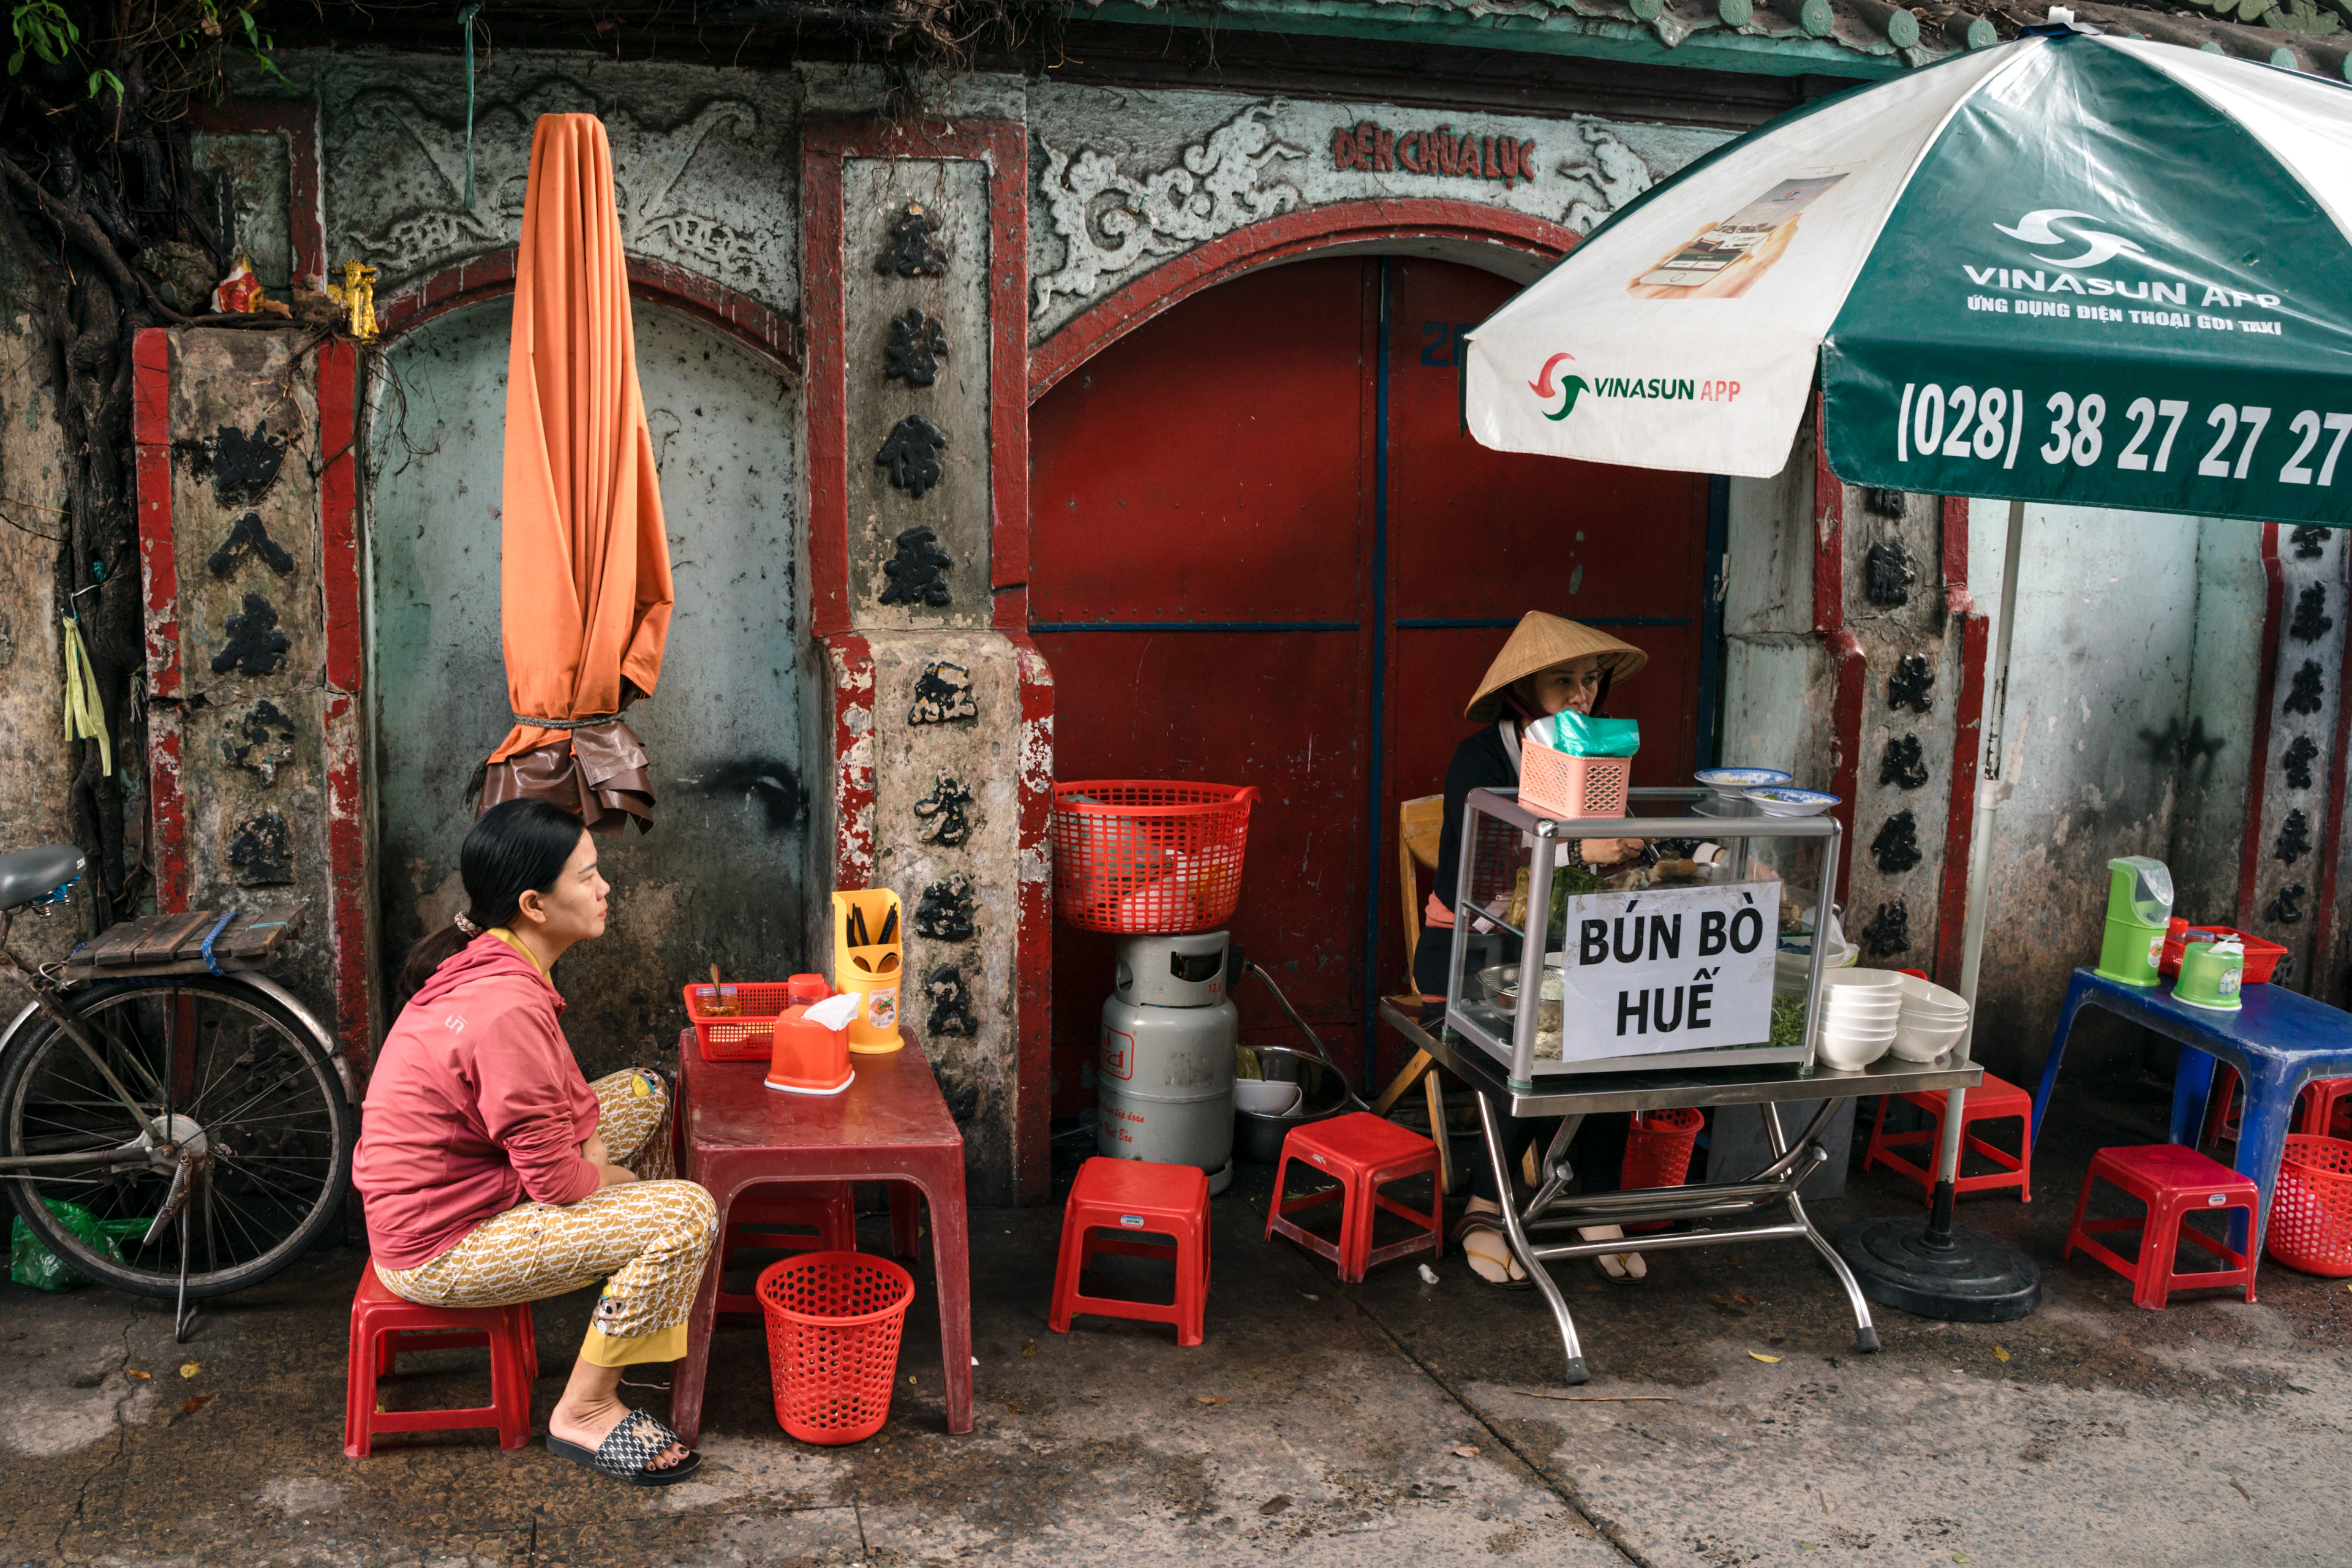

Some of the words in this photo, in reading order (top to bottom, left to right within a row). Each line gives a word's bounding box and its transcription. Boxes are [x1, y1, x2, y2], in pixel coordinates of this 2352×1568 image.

[1485, 136, 1536, 189] LỤC
[1962, 265, 2187, 306] VINASUN
[2201, 285, 2282, 308] APP
[1967, 294, 2008, 313] ỨNG
[2015, 300, 2070, 318] DỤNG
[2076, 305, 2123, 323] ĐIỆN
[2128, 310, 2191, 330] THOẠI
[2238, 320, 2282, 336] TAXI
[1595, 378, 1694, 400] VINASUN
[1700, 380, 1741, 402] APP
[1898, 383, 2023, 470] (028)
[2041, 391, 2106, 467] 38
[2117, 397, 2189, 472] 27
[2198, 403, 2271, 479] 27
[2279, 410, 2352, 486] 27
[1579, 900, 1681, 966] BÚN
[1698, 892, 1763, 957] BÒ
[1208, 982, 1223, 993] 13.6
[1616, 967, 1721, 1036] HUẾ
[1111, 1067, 1125, 1076] GAS
[1118, 1128, 1133, 1144] Bản
[1127, 1110, 1145, 1124] đoàn
